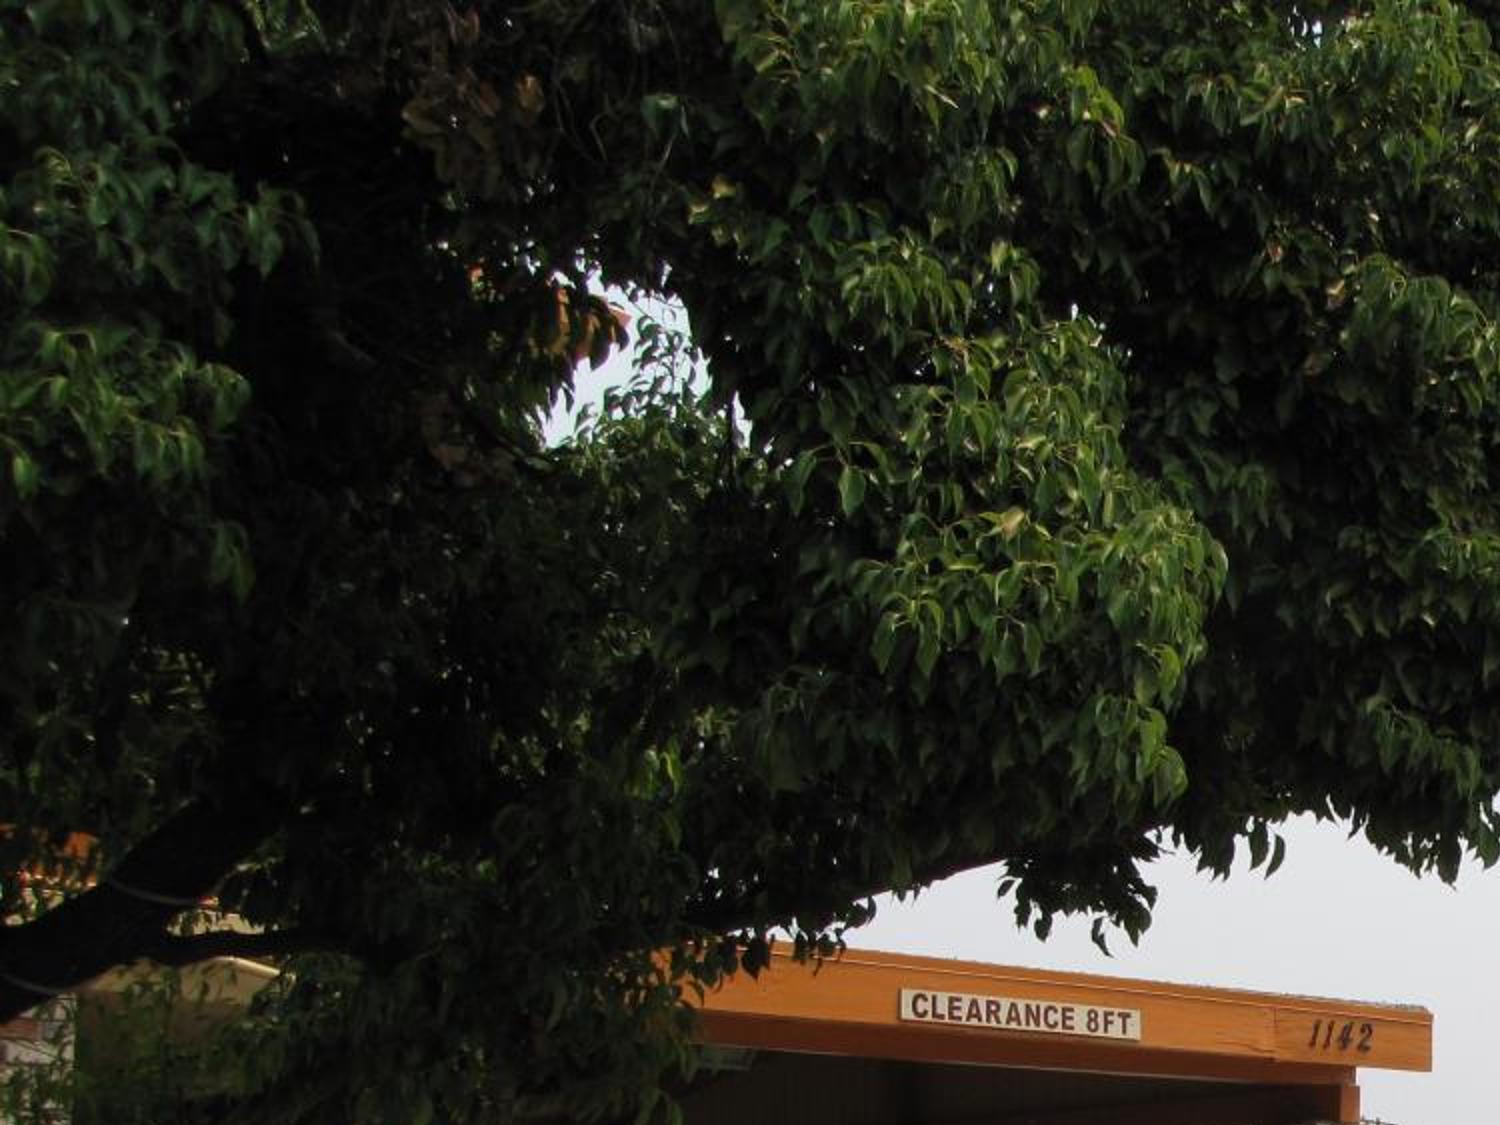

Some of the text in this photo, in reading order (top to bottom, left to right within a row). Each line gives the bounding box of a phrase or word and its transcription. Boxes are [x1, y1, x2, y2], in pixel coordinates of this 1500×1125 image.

[911, 992, 1132, 1035] CLEARANCE 8FT
[1308, 1018, 1374, 1053] 1142
